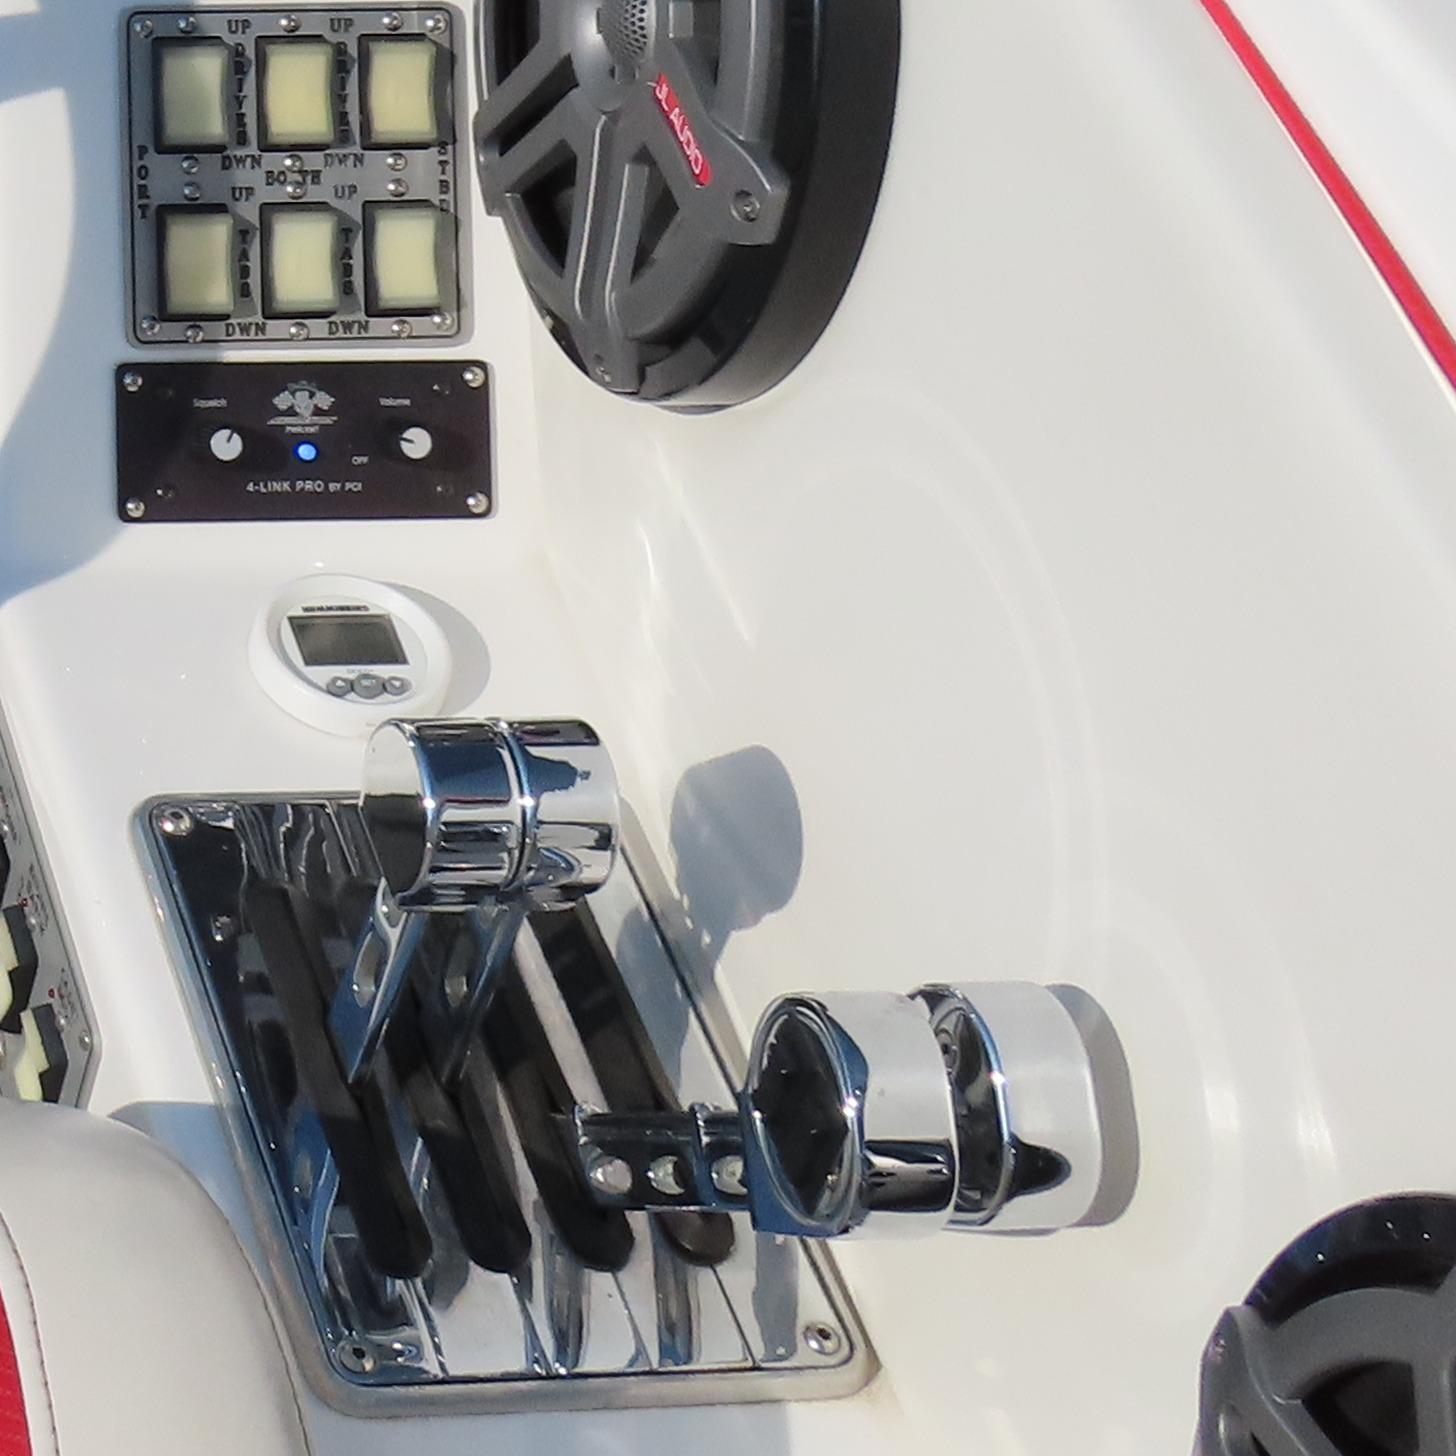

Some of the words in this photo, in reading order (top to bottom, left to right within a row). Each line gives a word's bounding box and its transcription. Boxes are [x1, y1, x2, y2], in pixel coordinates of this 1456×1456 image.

[227, 20, 251, 34] UP
[330, 18, 354, 33] UP
[221, 154, 262, 169] DWN
[324, 153, 364, 169] DWN
[137, 146, 150, 219] PORT
[231, 186, 255, 201] UP
[334, 185, 357, 199] UP
[239, 229, 251, 299] TABS
[341, 227, 354, 296] TABS
[225, 322, 267, 337] DWN
[327, 320, 369, 336] DWN
[351, 456, 369, 465] OFF
[246, 481, 290, 492] 4-LINK
[296, 481, 324, 491] PRO
[328, 483, 341, 491] BY
[345, 482, 362, 491] PCI
